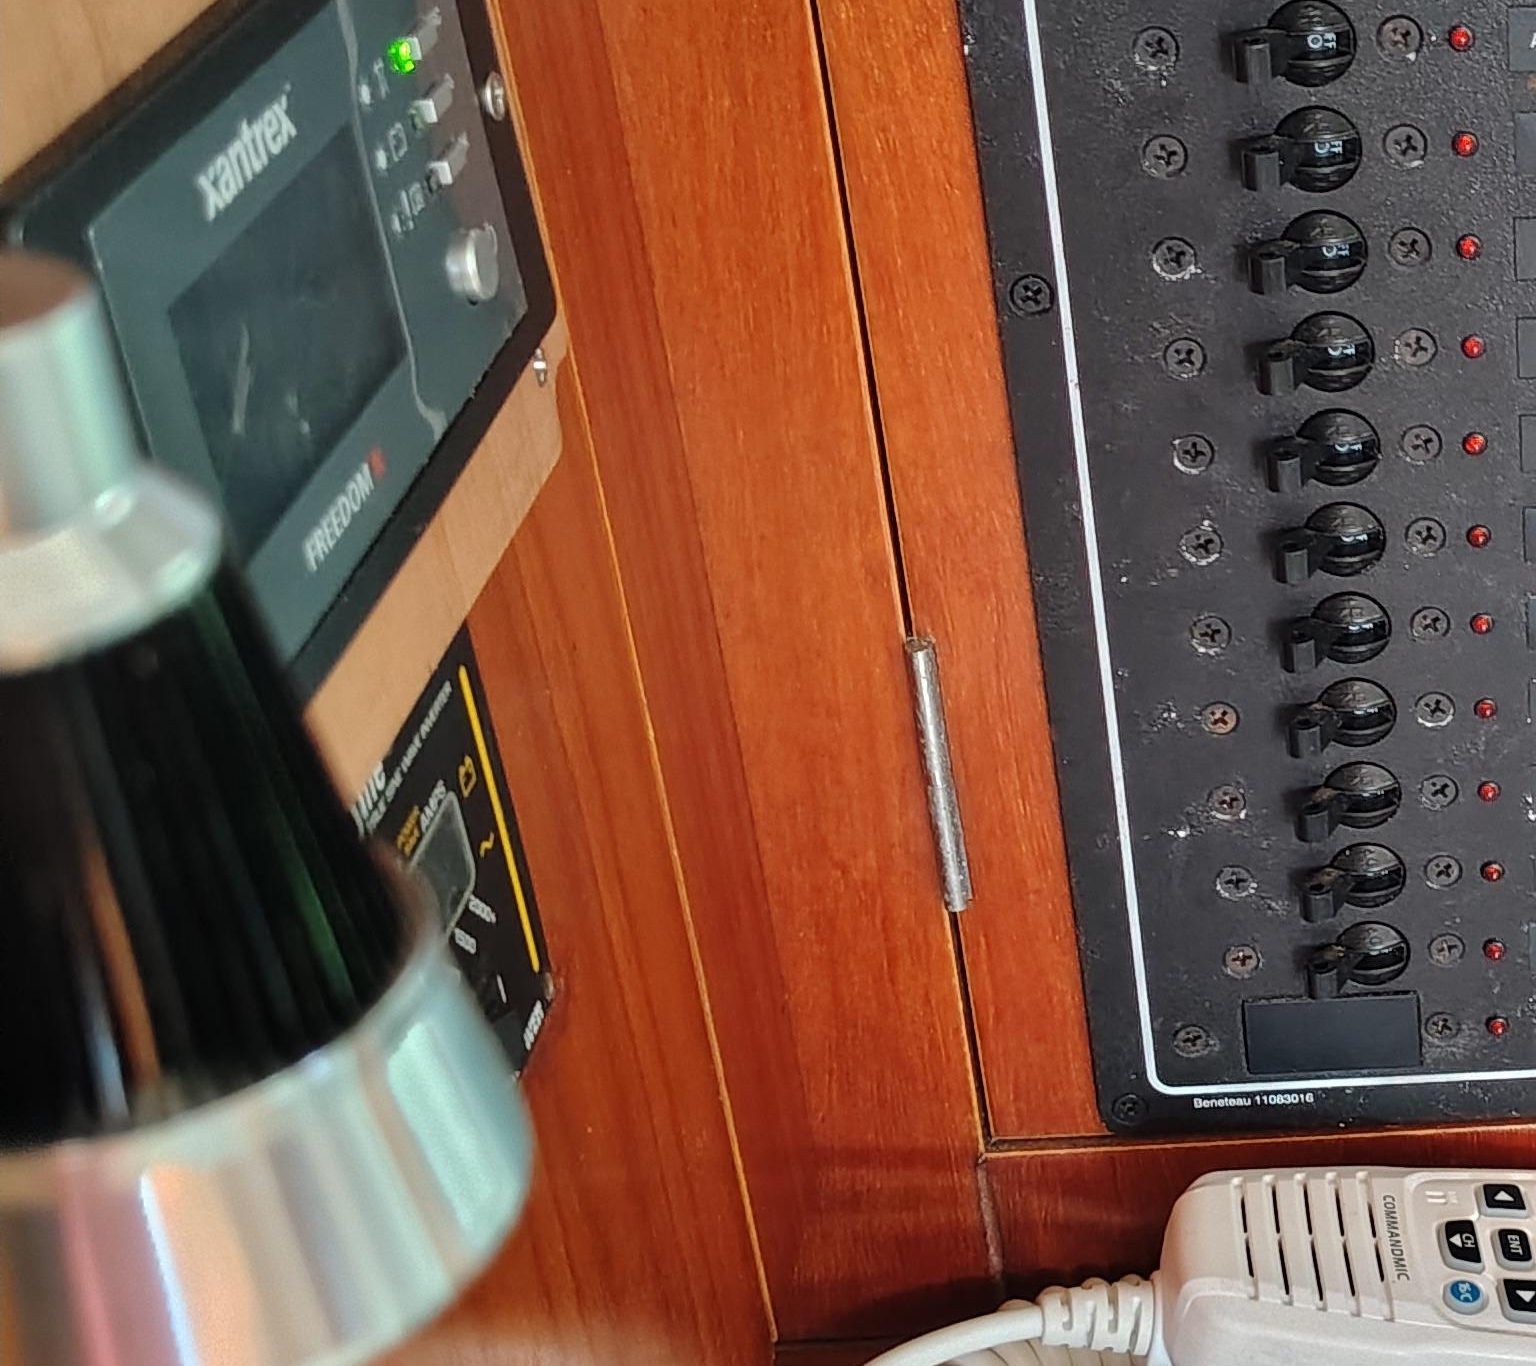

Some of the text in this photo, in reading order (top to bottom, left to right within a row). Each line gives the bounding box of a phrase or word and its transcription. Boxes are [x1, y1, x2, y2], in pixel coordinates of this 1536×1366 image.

[195, 93, 297, 221] xantrex
[303, 463, 374, 571] FREEDOM
[1194, 1097, 1251, 1108] Beneteau
[1383, 1195, 1410, 1281] COMMANDMIC
[1464, 1233, 1475, 1248] CH
[1507, 1235, 1522, 1255] ENT
